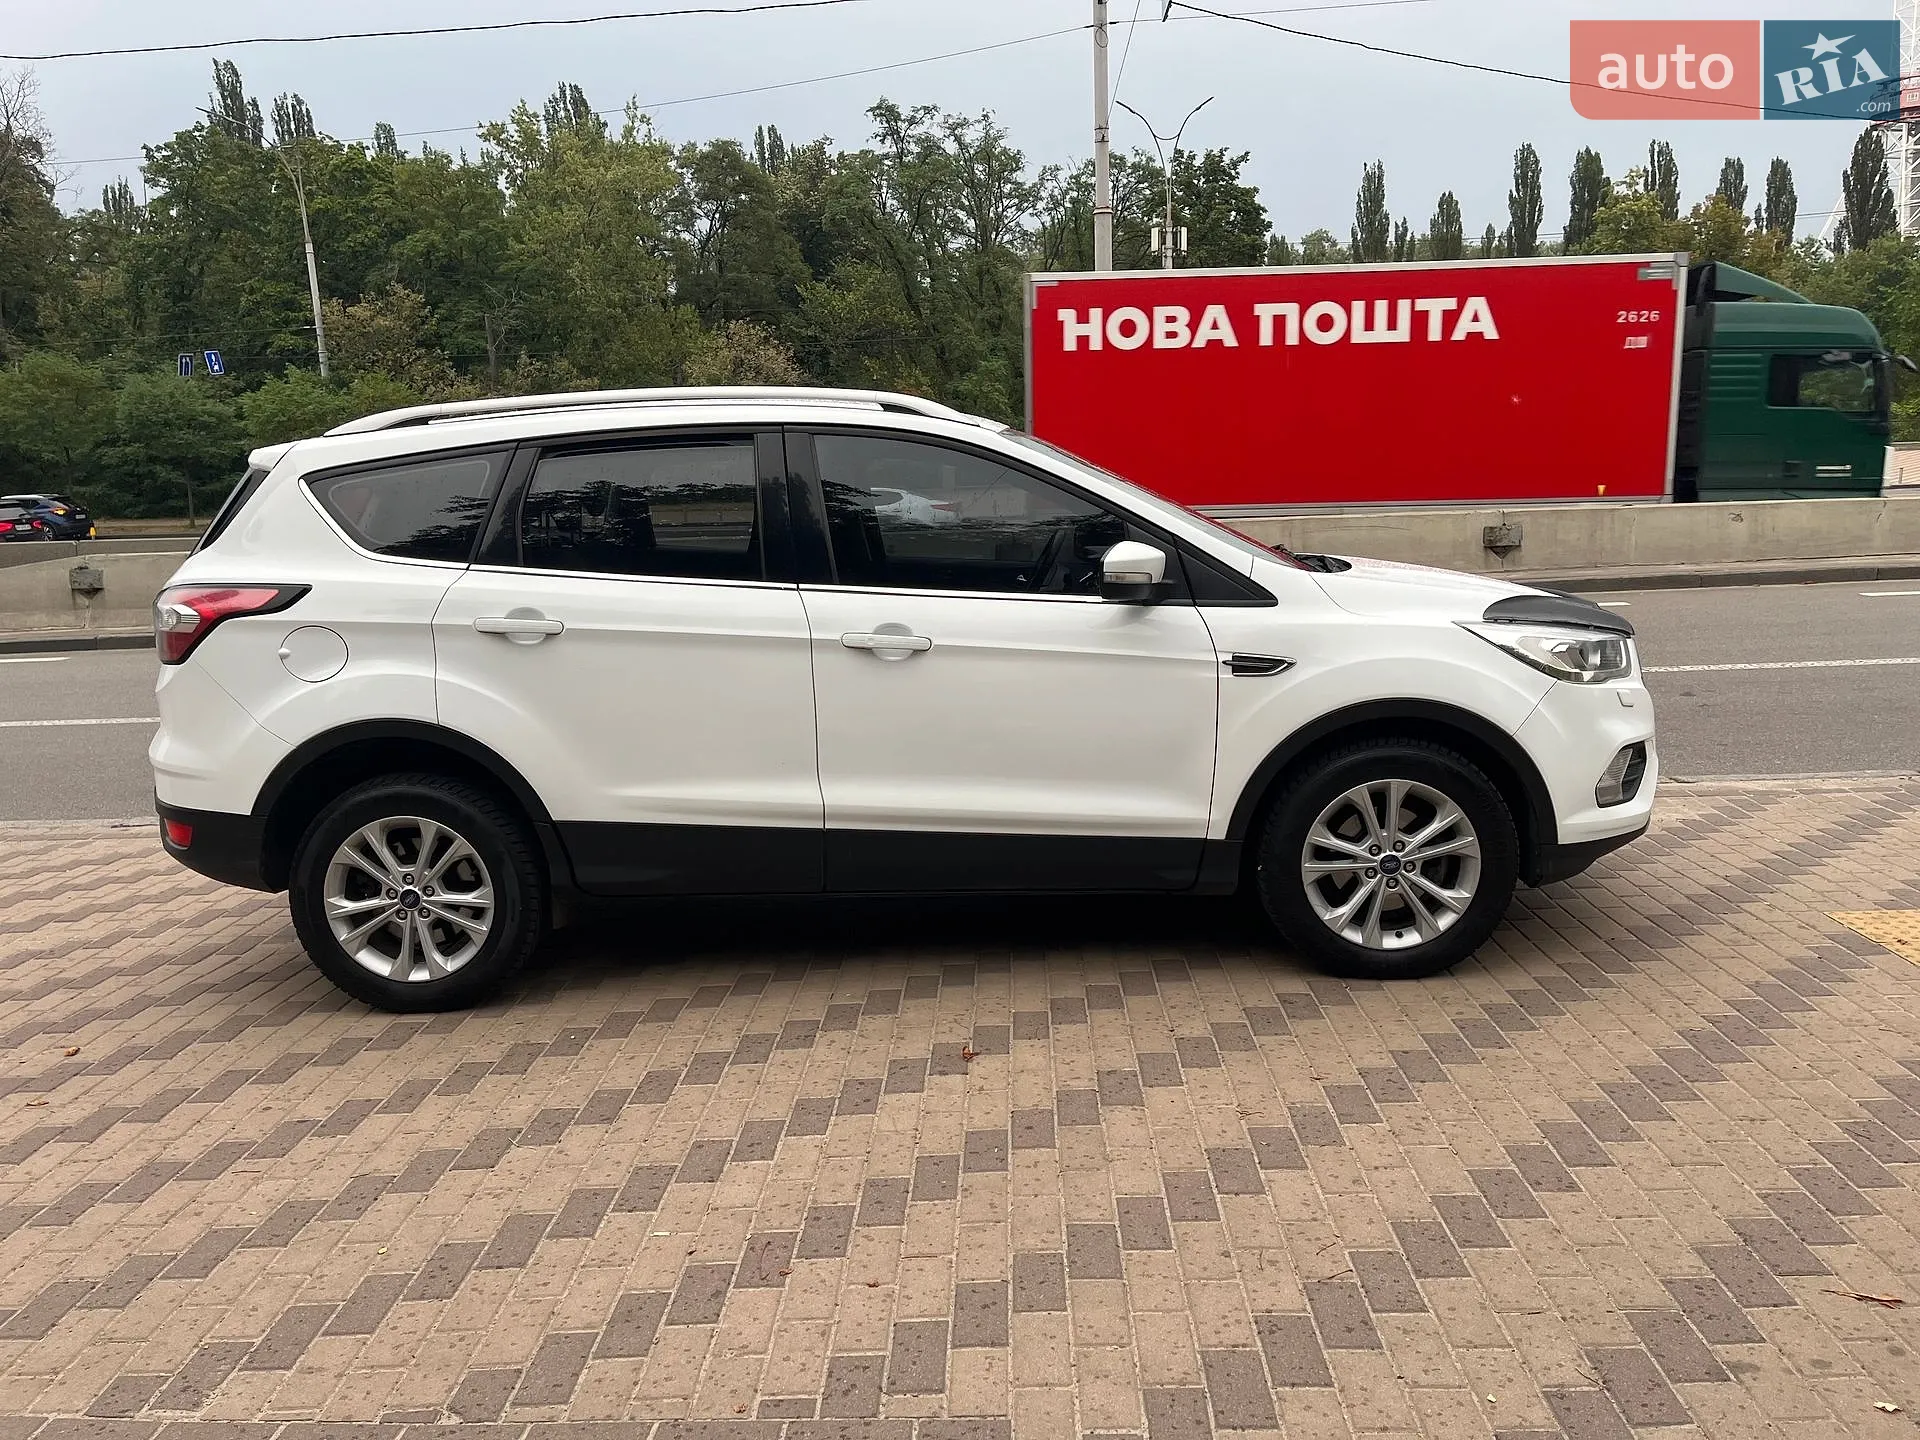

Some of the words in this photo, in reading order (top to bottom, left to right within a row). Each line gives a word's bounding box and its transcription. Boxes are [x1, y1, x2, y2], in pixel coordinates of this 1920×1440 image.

[1057, 305, 1238, 351] НОВА
[1253, 296, 1499, 346] ПОШТА
[1616, 310, 1660, 323] 2626
